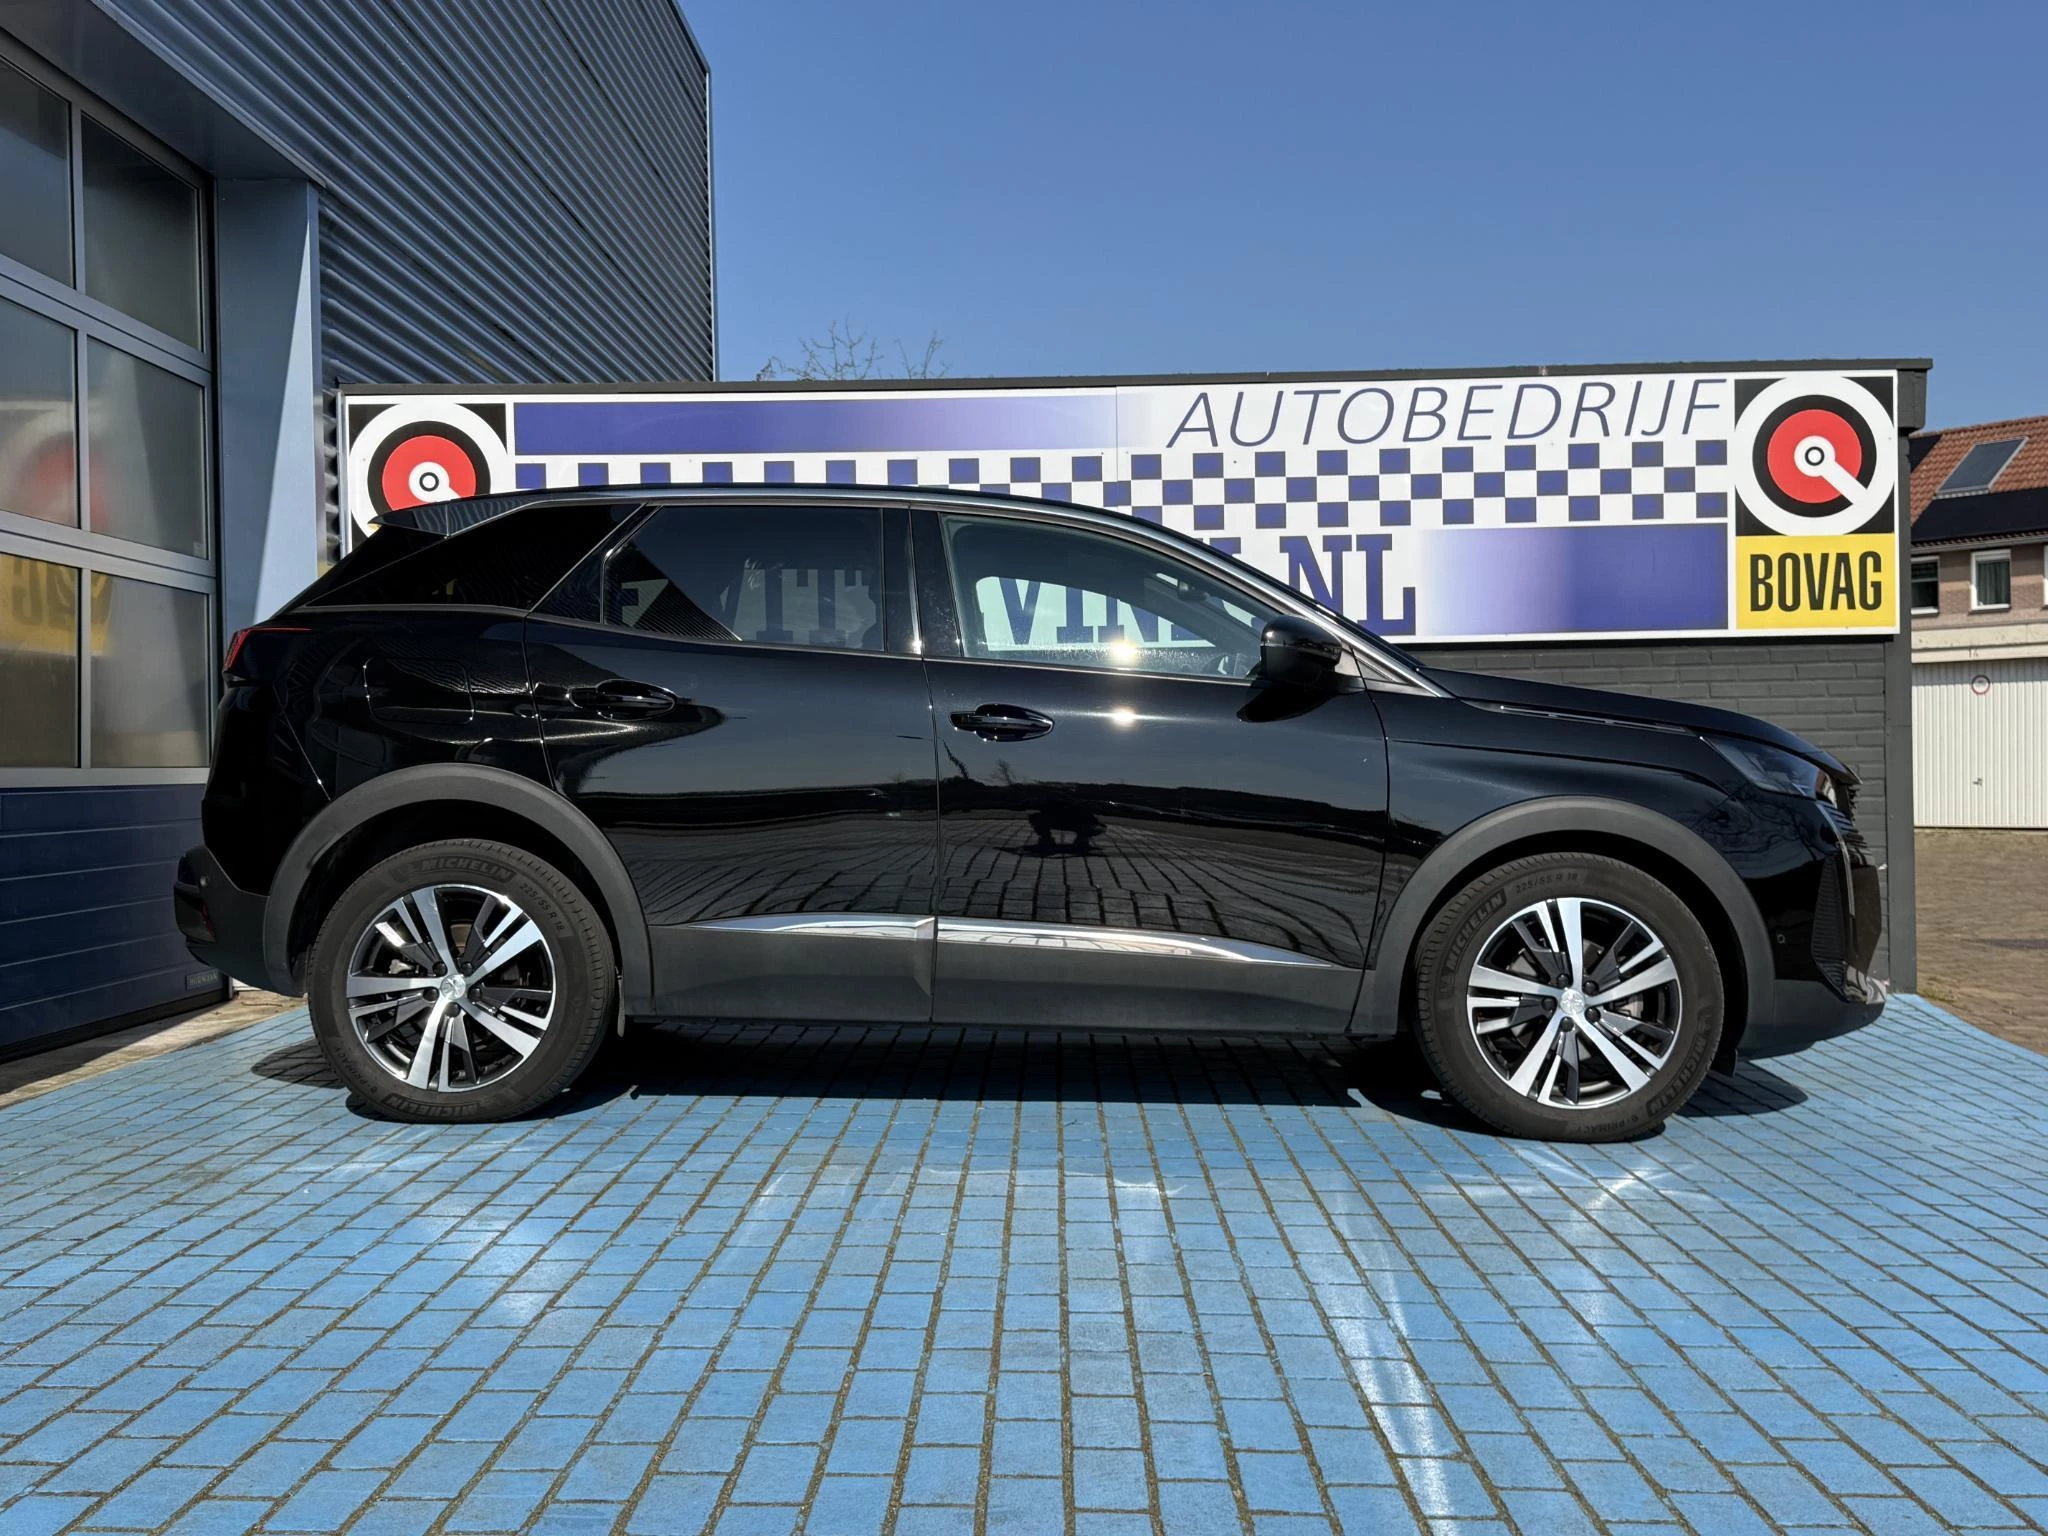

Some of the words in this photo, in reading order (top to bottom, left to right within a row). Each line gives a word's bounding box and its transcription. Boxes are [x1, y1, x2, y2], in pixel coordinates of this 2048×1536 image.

[1167, 377, 1727, 449] AUTOBEDRIJF
[1748, 551, 1883, 613] BOVAG
[421, 858, 512, 882] MICHELIN
[1446, 891, 1506, 970] MICHELIN
